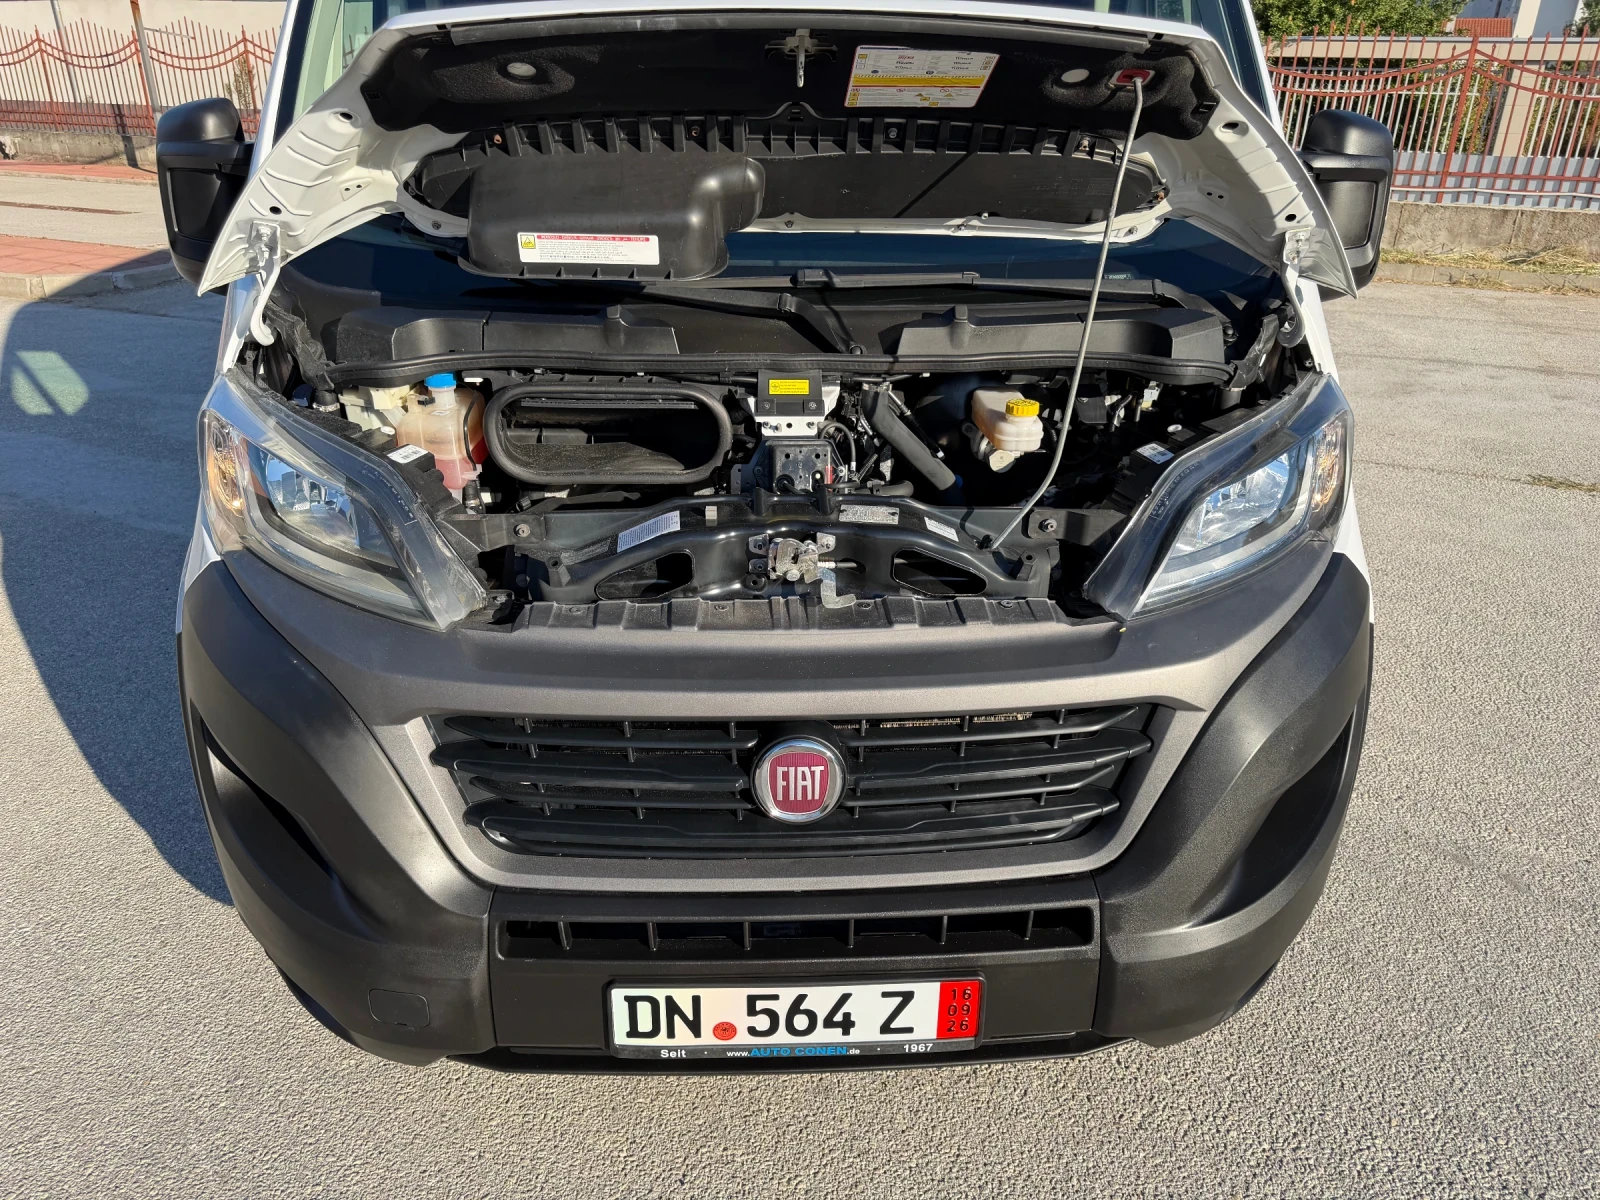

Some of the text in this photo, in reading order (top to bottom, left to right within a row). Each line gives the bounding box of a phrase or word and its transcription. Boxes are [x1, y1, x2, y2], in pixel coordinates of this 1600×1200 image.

[776, 765, 825, 801] FIAT
[951, 988, 972, 1001] 16
[623, 994, 702, 1039] DN
[746, 992, 856, 1037] 564
[879, 990, 915, 1035] Z
[947, 1003, 971, 1017] 09
[946, 1019, 969, 1032] 26
[660, 1049, 687, 1058] Seit
[903, 1043, 934, 1053] 1967
